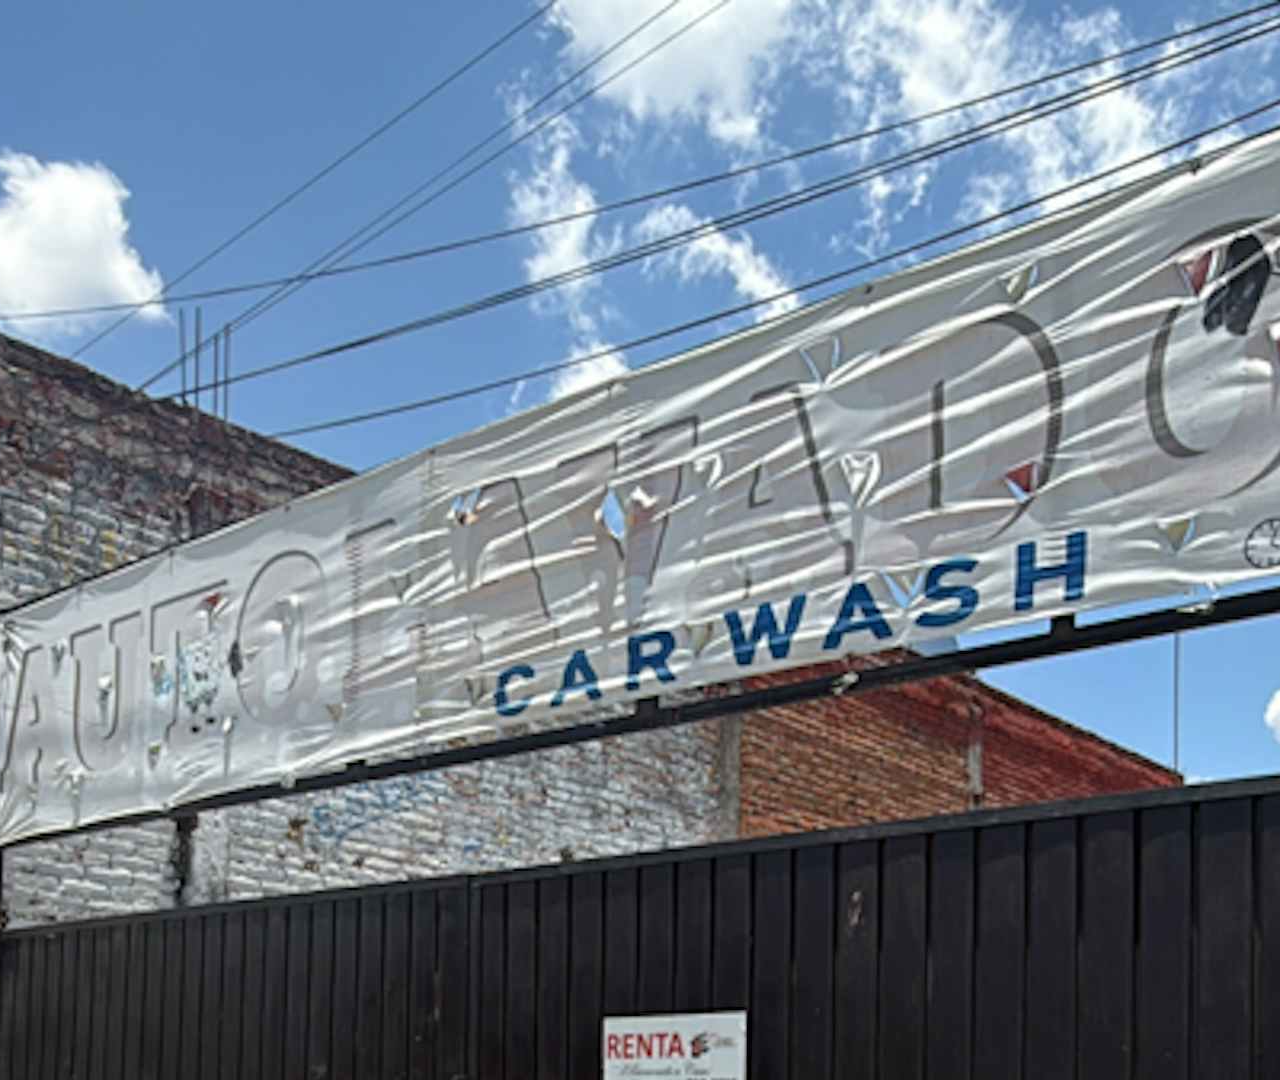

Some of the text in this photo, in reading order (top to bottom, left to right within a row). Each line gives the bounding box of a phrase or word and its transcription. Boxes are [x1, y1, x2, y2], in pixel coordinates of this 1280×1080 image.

[494, 530, 1088, 717] CAR WASH
[607, 1030, 686, 1060] RENTA
